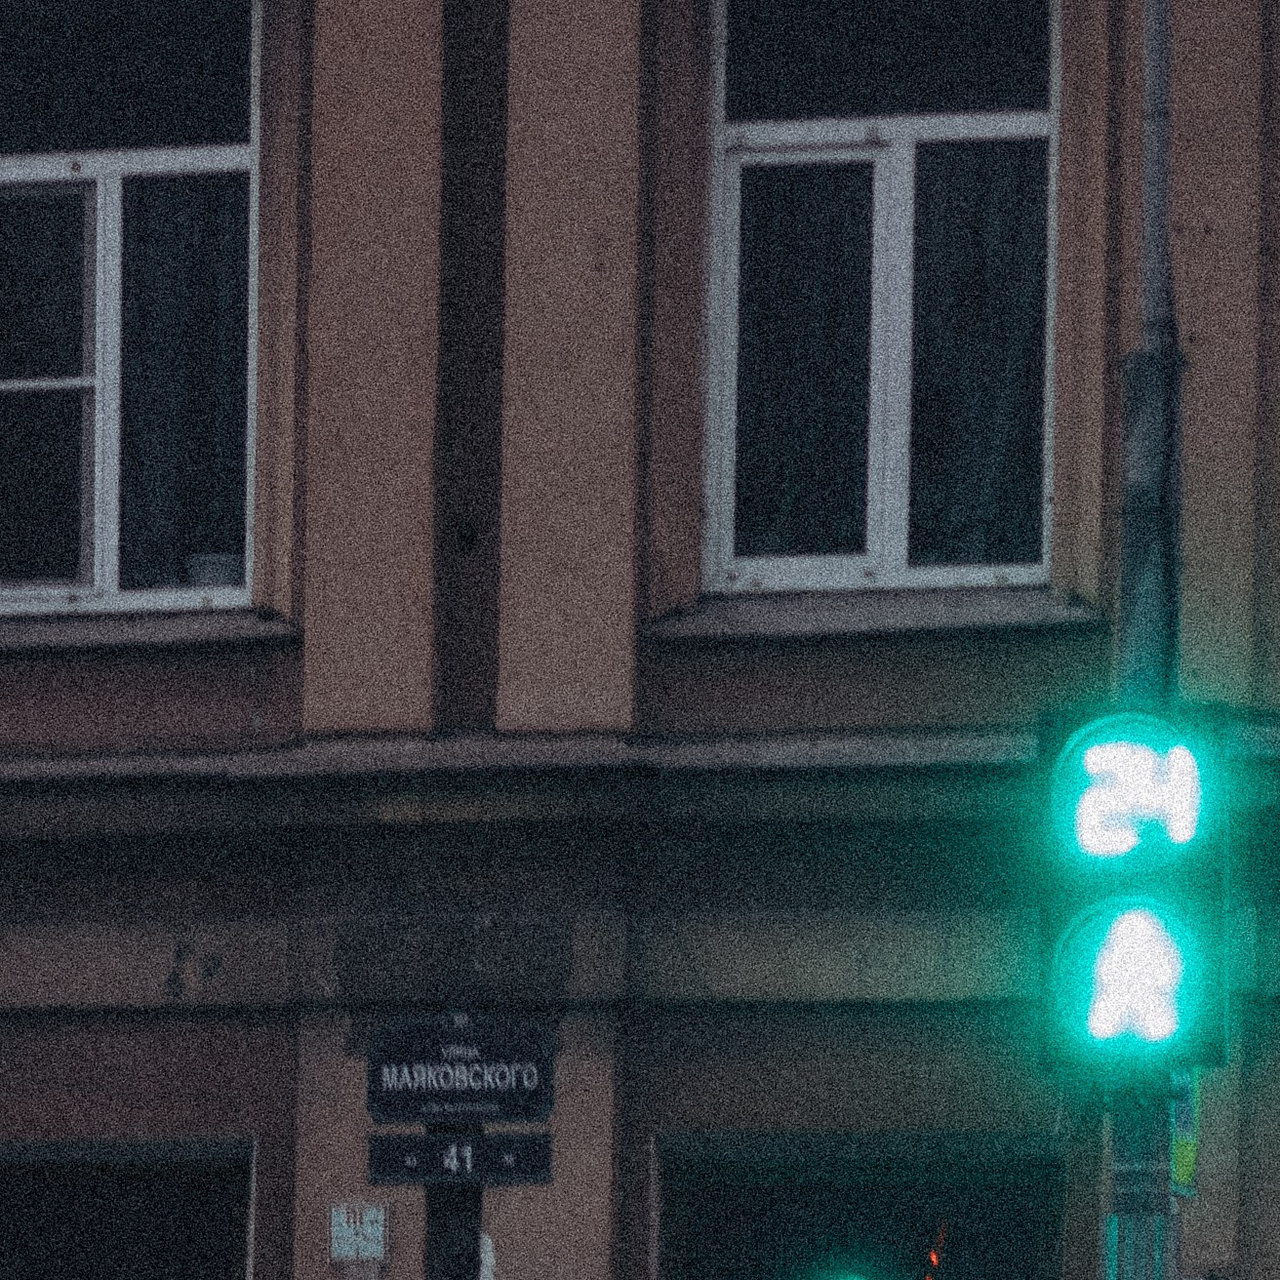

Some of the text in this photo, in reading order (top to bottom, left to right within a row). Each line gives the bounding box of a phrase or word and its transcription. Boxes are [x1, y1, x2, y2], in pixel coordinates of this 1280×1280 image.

[1075, 741, 1199, 856] 24
[382, 1063, 538, 1091] МАЯКОВСКОГО
[443, 1143, 473, 1174] 41
